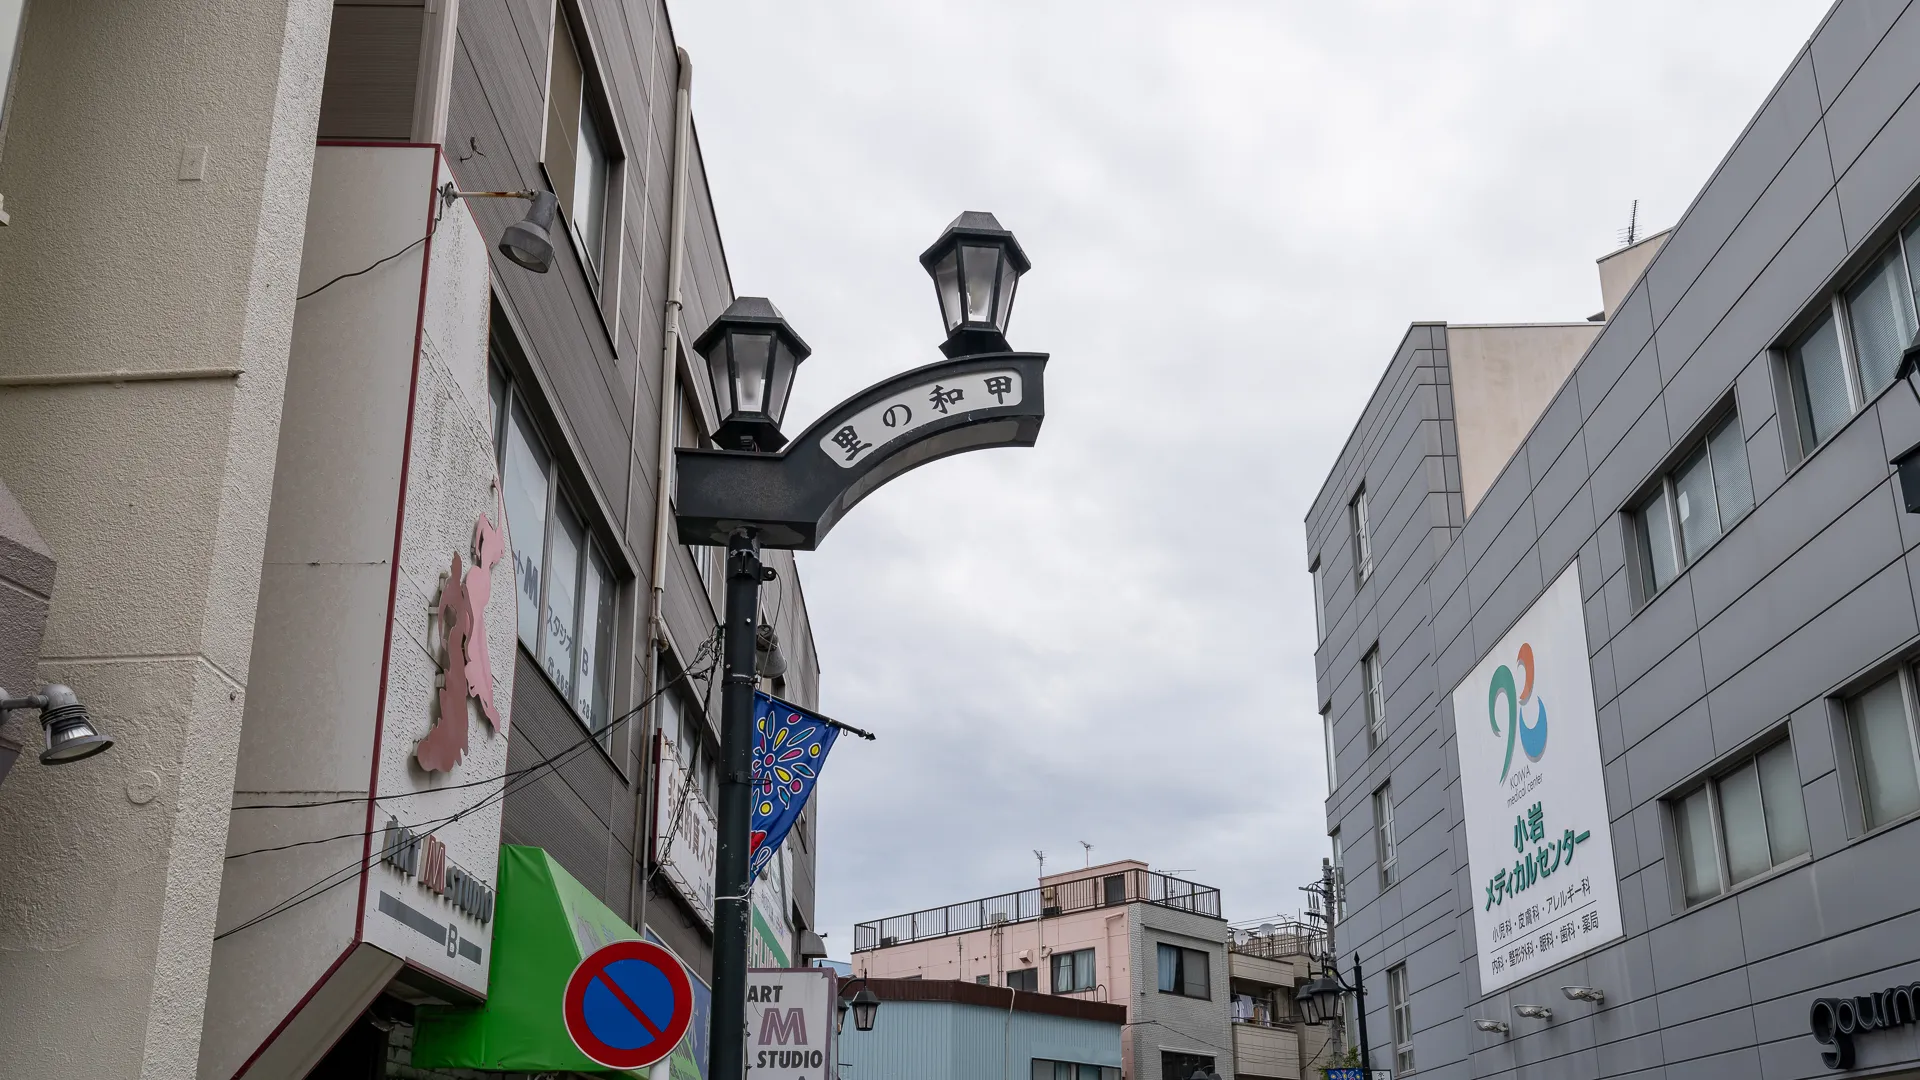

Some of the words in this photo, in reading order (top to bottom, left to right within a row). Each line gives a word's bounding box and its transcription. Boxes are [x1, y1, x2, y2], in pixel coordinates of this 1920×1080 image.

[1506, 781, 1527, 808] medical
[1527, 773, 1543, 793] center
[1509, 765, 1531, 790] KOIWA
[1513, 801, 1545, 854] 小岩
[381, 820, 422, 877] ART
[418, 834, 446, 895] M
[443, 865, 493, 924] STUDIO
[1485, 829, 1590, 911] メディカルセンター
[446, 923, 458, 958] B
[746, 985, 783, 1003] ART
[758, 1008, 808, 1045] M
[757, 1050, 823, 1069] STUDIO
